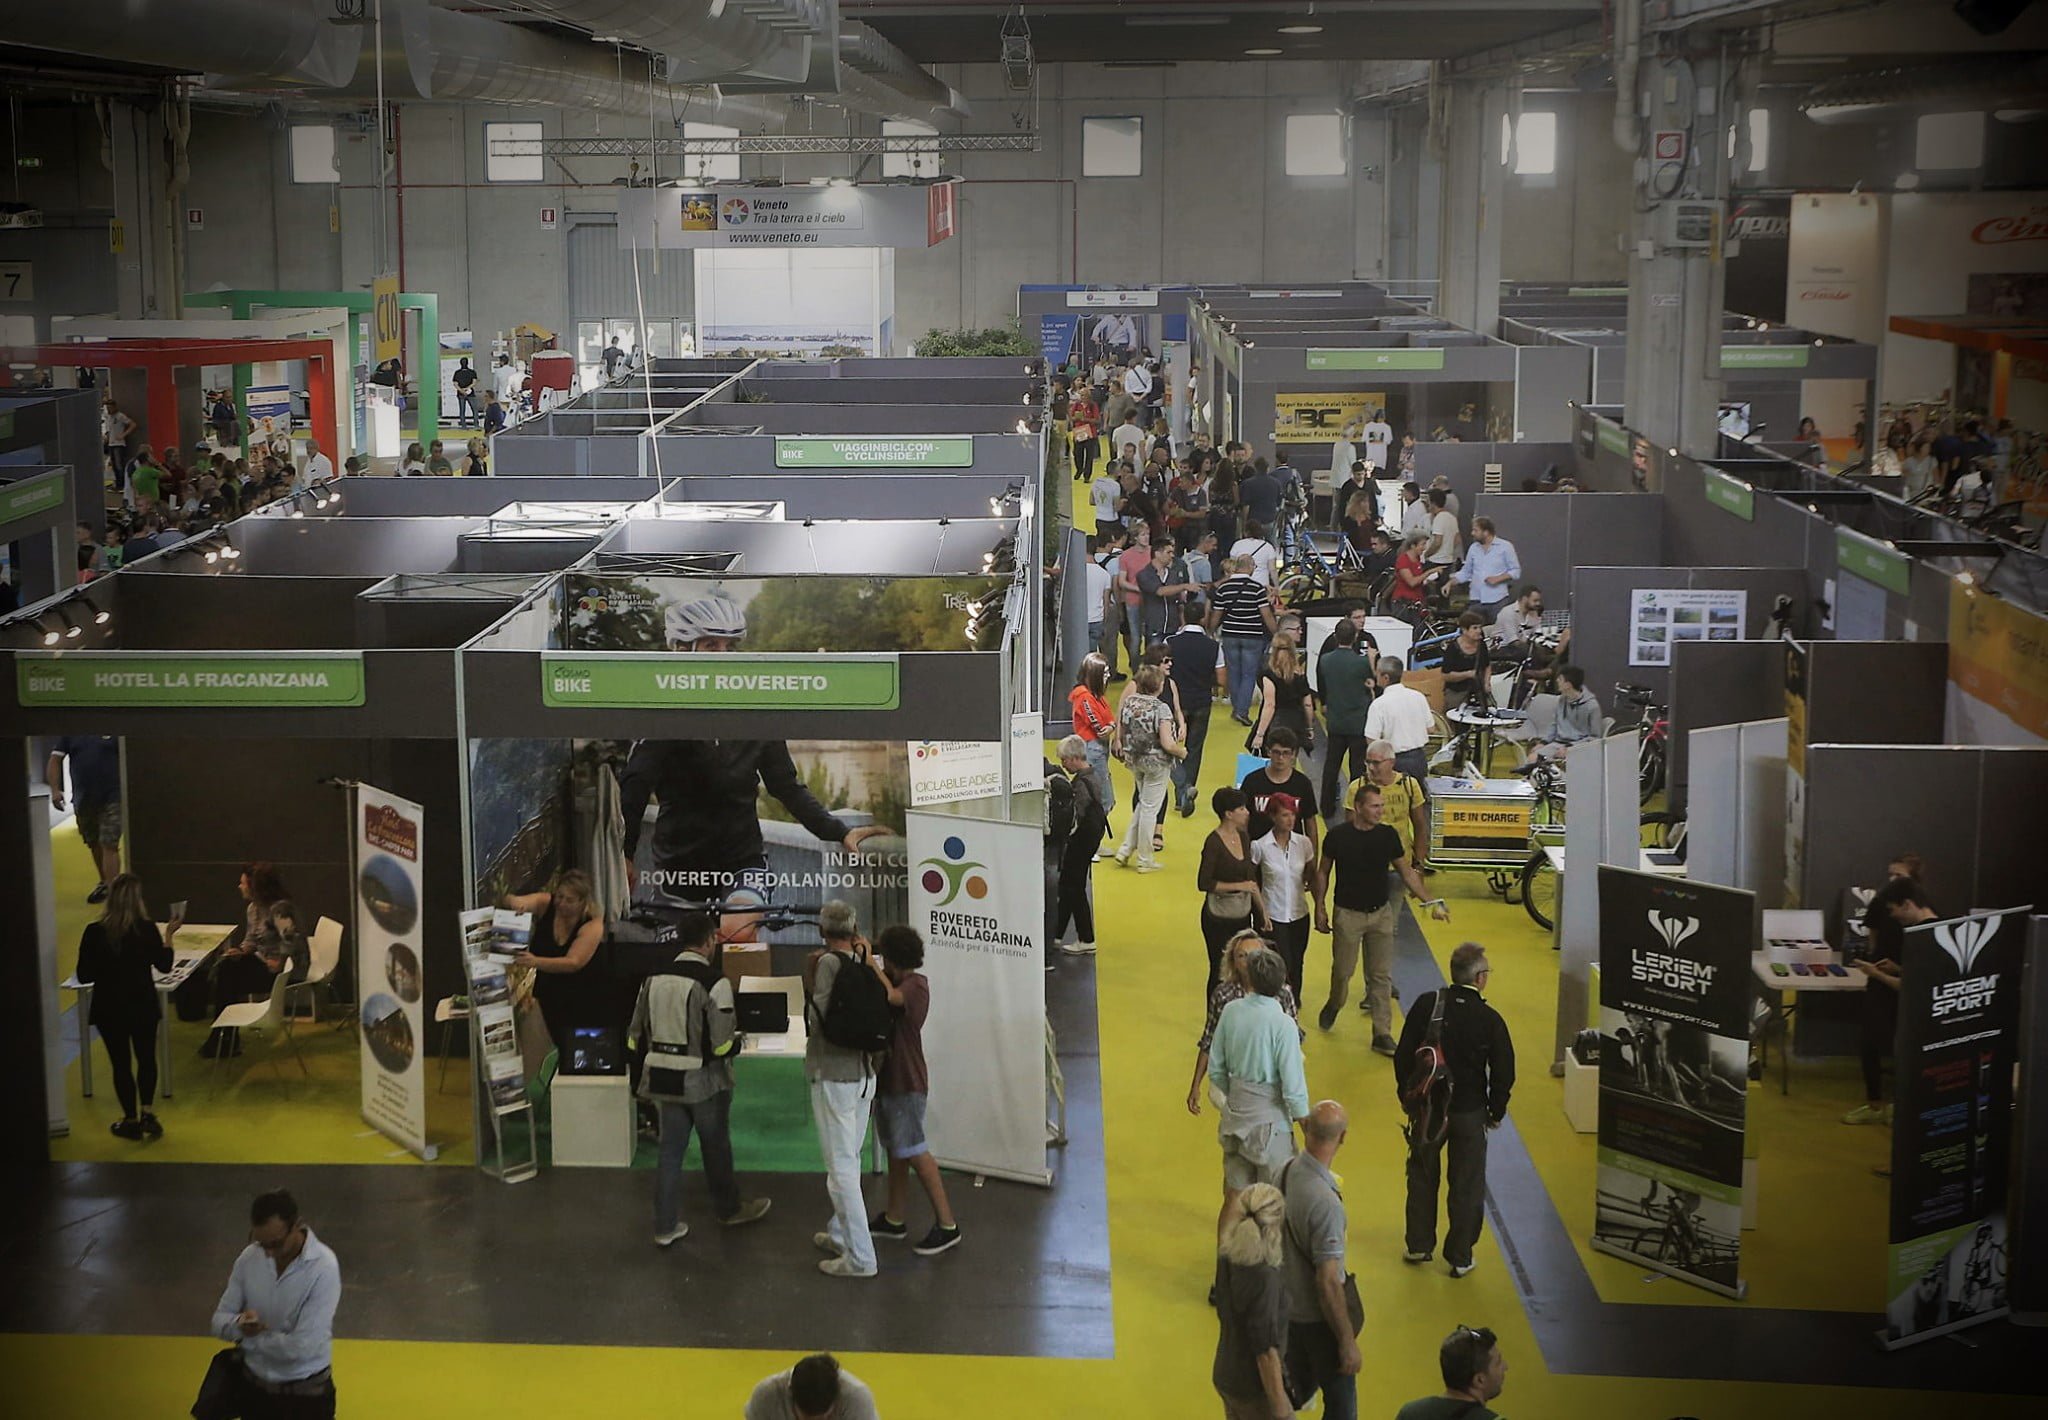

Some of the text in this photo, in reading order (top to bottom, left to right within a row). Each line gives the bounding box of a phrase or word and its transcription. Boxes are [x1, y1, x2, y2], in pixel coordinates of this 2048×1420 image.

[753, 199, 788, 210] Veneto
[753, 212, 845, 223] Tra la terra e il cielo
[729, 233, 818, 243] www.veneto.eu
[1971, 216, 2048, 244] Cin
[4, 273, 21, 297] 7
[377, 292, 398, 343] C10
[1295, 409, 1341, 428] BC
[782, 450, 804, 459] BIKE
[833, 443, 933, 452] VIAGGINBICI.COM
[845, 452, 927, 461] CYCLINSIDE.IT
[30, 678, 66, 692] BIKE
[95, 673, 329, 687] HOTEL LA FRACANZANA
[554, 679, 592, 693] BIKE
[656, 674, 828, 690] VISIT ROVERETO
[915, 772, 999, 793] CICLABILE ADIGE
[1453, 812, 1520, 823] BE IN CHARGE
[825, 852, 843, 866] IN
[848, 852, 882, 867] BICI
[640, 871, 908, 888] ROVERETO, PEDALANDO LUNG
[931, 911, 997, 930] ROVERETO
[931, 923, 1032, 948] E VALLAGARINA
[931, 937, 964, 949] Azienda
[967, 943, 980, 953] per
[991, 945, 1028, 958] Turismo
[1631, 965, 1712, 995] SPORT
[1931, 990, 1996, 1017] SPORT
